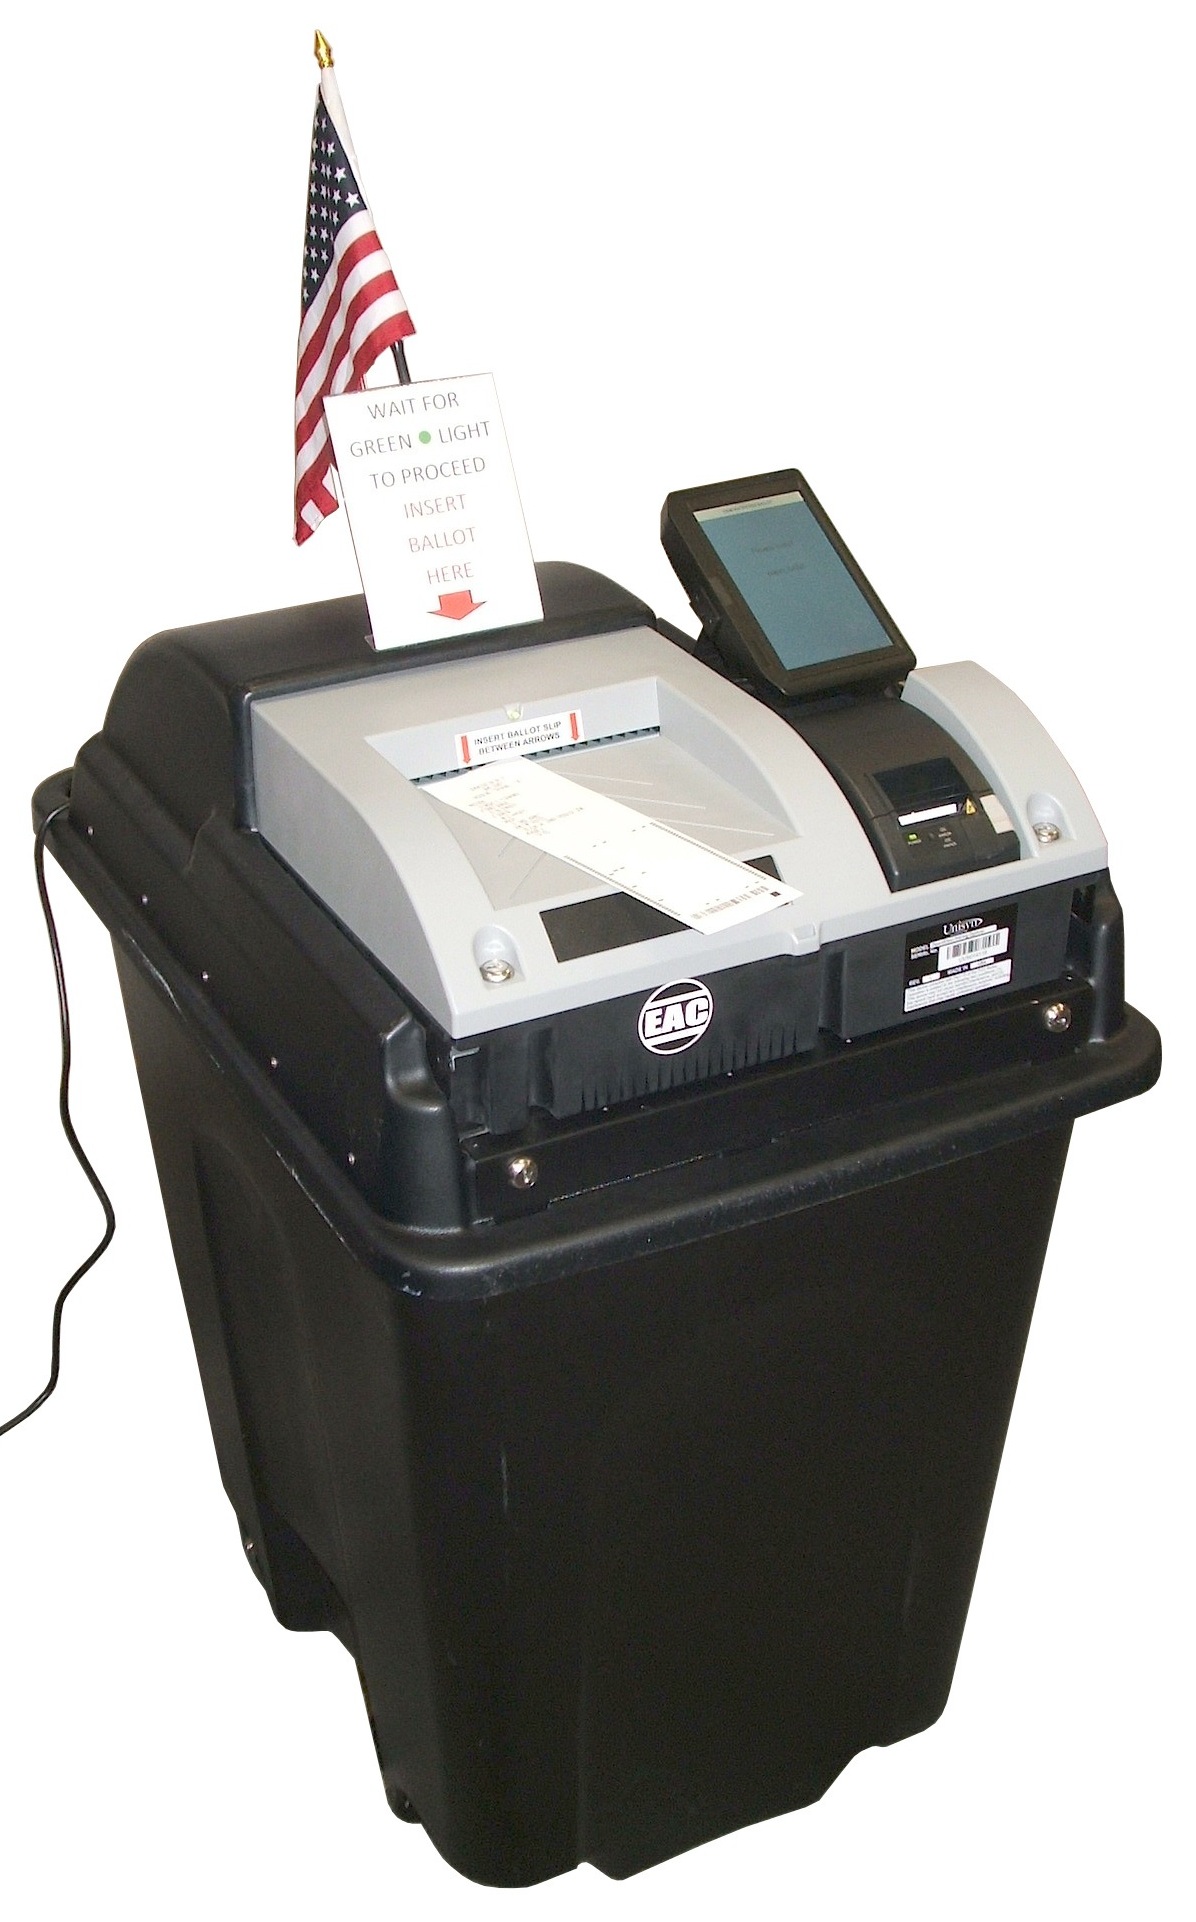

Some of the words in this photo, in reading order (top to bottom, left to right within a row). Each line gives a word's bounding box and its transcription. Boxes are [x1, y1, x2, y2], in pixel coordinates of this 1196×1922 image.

[367, 399, 416, 420] WAIT
[422, 391, 460, 412] FOR
[350, 434, 412, 457] GREEN
[438, 421, 491, 443] LIGHT
[369, 472, 396, 489] TO
[401, 456, 486, 484] PROCEED
[404, 494, 467, 519] INSERT
[408, 527, 477, 553] BALLOT
[426, 562, 474, 585] HERE
[474, 733, 505, 746] INSERT
[507, 725, 541, 739] BALLOT
[543, 720, 562, 732] SLIP
[478, 740, 521, 755] BETWEEN
[522, 731, 560, 746] ARROWS
[943, 918, 982, 936] Unisyn
[644, 997, 709, 1038] EAC
